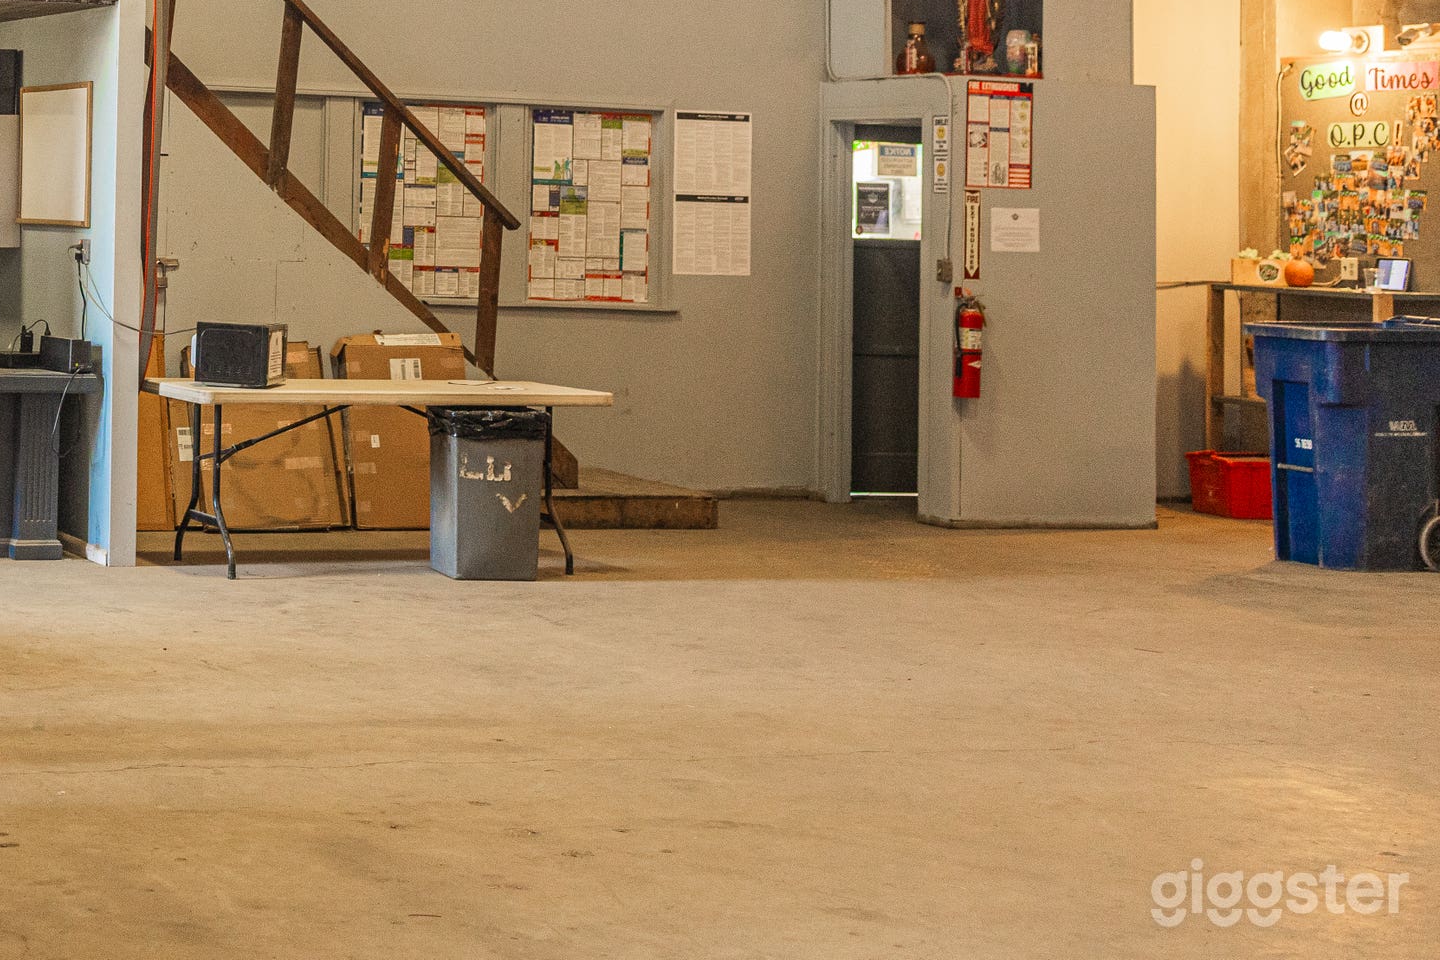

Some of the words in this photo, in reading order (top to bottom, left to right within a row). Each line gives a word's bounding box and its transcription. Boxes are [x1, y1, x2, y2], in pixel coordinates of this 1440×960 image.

[1300, 65, 1354, 98] Good
[1368, 67, 1434, 90] Times
[1349, 91, 1369, 117] @
